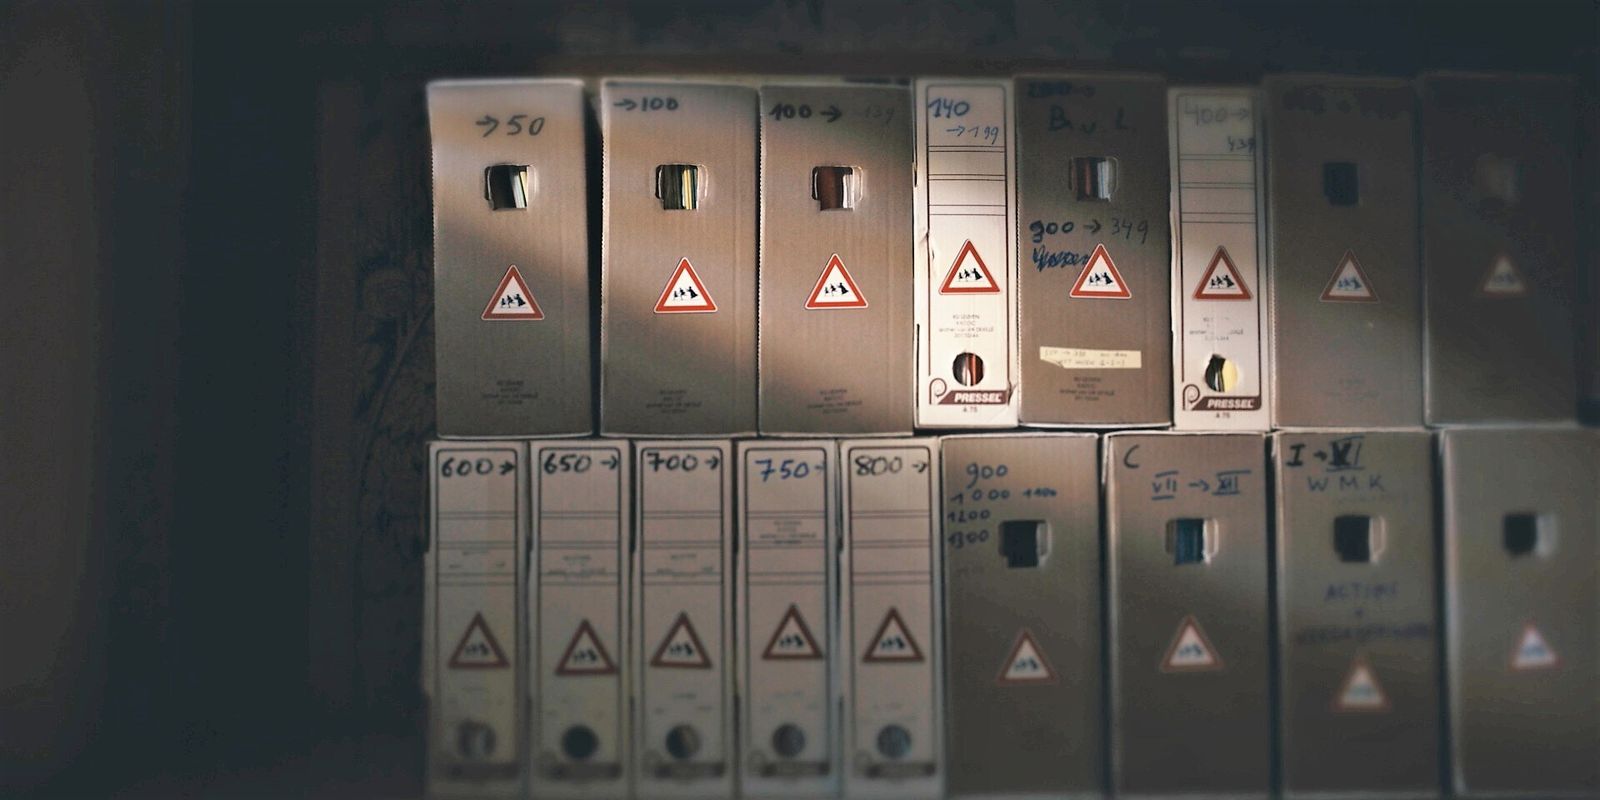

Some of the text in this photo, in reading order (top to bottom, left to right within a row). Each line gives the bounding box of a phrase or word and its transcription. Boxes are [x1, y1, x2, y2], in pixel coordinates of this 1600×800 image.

[641, 97, 679, 111] 100
[769, 103, 812, 121] 100
[928, 97, 970, 119] 140
[1184, 97, 1228, 125] 400
[507, 114, 545, 136] 50
[970, 126, 999, 144] 199
[1111, 218, 1149, 244] 349
[954, 393, 1002, 403] PRESSEL
[1207, 399, 1255, 409] PRESSEL
[442, 458, 494, 477] 600
[543, 453, 592, 474] 650
[647, 452, 698, 472] 700
[755, 458, 809, 482] 750
[854, 455, 903, 476] 800
[966, 462, 1008, 489] 900
